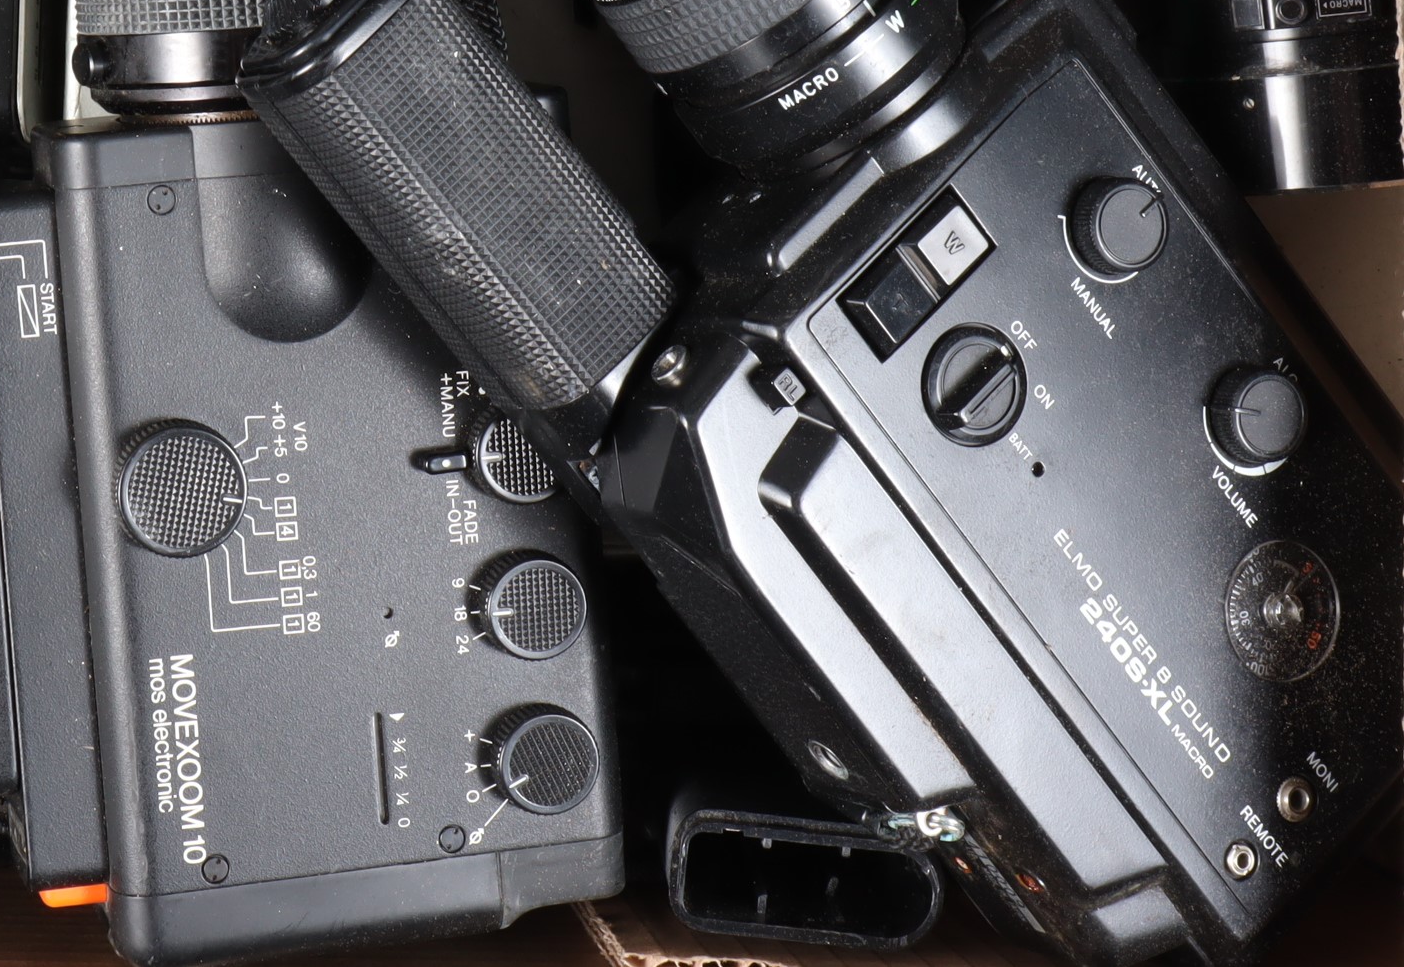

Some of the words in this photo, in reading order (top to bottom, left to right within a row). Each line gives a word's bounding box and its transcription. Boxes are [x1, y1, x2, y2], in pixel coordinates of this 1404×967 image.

[884, 9, 905, 34] W
[777, 66, 841, 112] MACRO
[943, 230, 966, 256] W
[38, 281, 59, 336] START
[1070, 276, 1119, 340] MANUAL
[1010, 319, 1038, 351] OFF
[455, 369, 471, 398] FIX
[1033, 383, 1055, 410] ON
[271, 400, 286, 431] +10
[272, 434, 288, 458] +5
[1008, 432, 1034, 461] BATT
[445, 479, 464, 546] IN-OUT
[1211, 463, 1260, 530] VOLUME
[462, 498, 479, 545] FADE
[451, 576, 466, 589] 9
[306, 611, 322, 633] 60
[453, 604, 468, 622] 18
[455, 634, 470, 656] 24
[1052, 527, 1103, 592] ELMO
[1102, 592, 1158, 665] SUPER
[1170, 684, 1232, 763] SOUND
[148, 657, 167, 704] mos
[169, 653, 206, 830] MOVEXOOM
[1171, 723, 1215, 780] MACRO
[152, 708, 178, 814] electronic
[464, 761, 478, 774] A
[1305, 751, 1340, 793] MONI
[182, 834, 207, 865] 10
[1238, 804, 1289, 869] REMOTE
